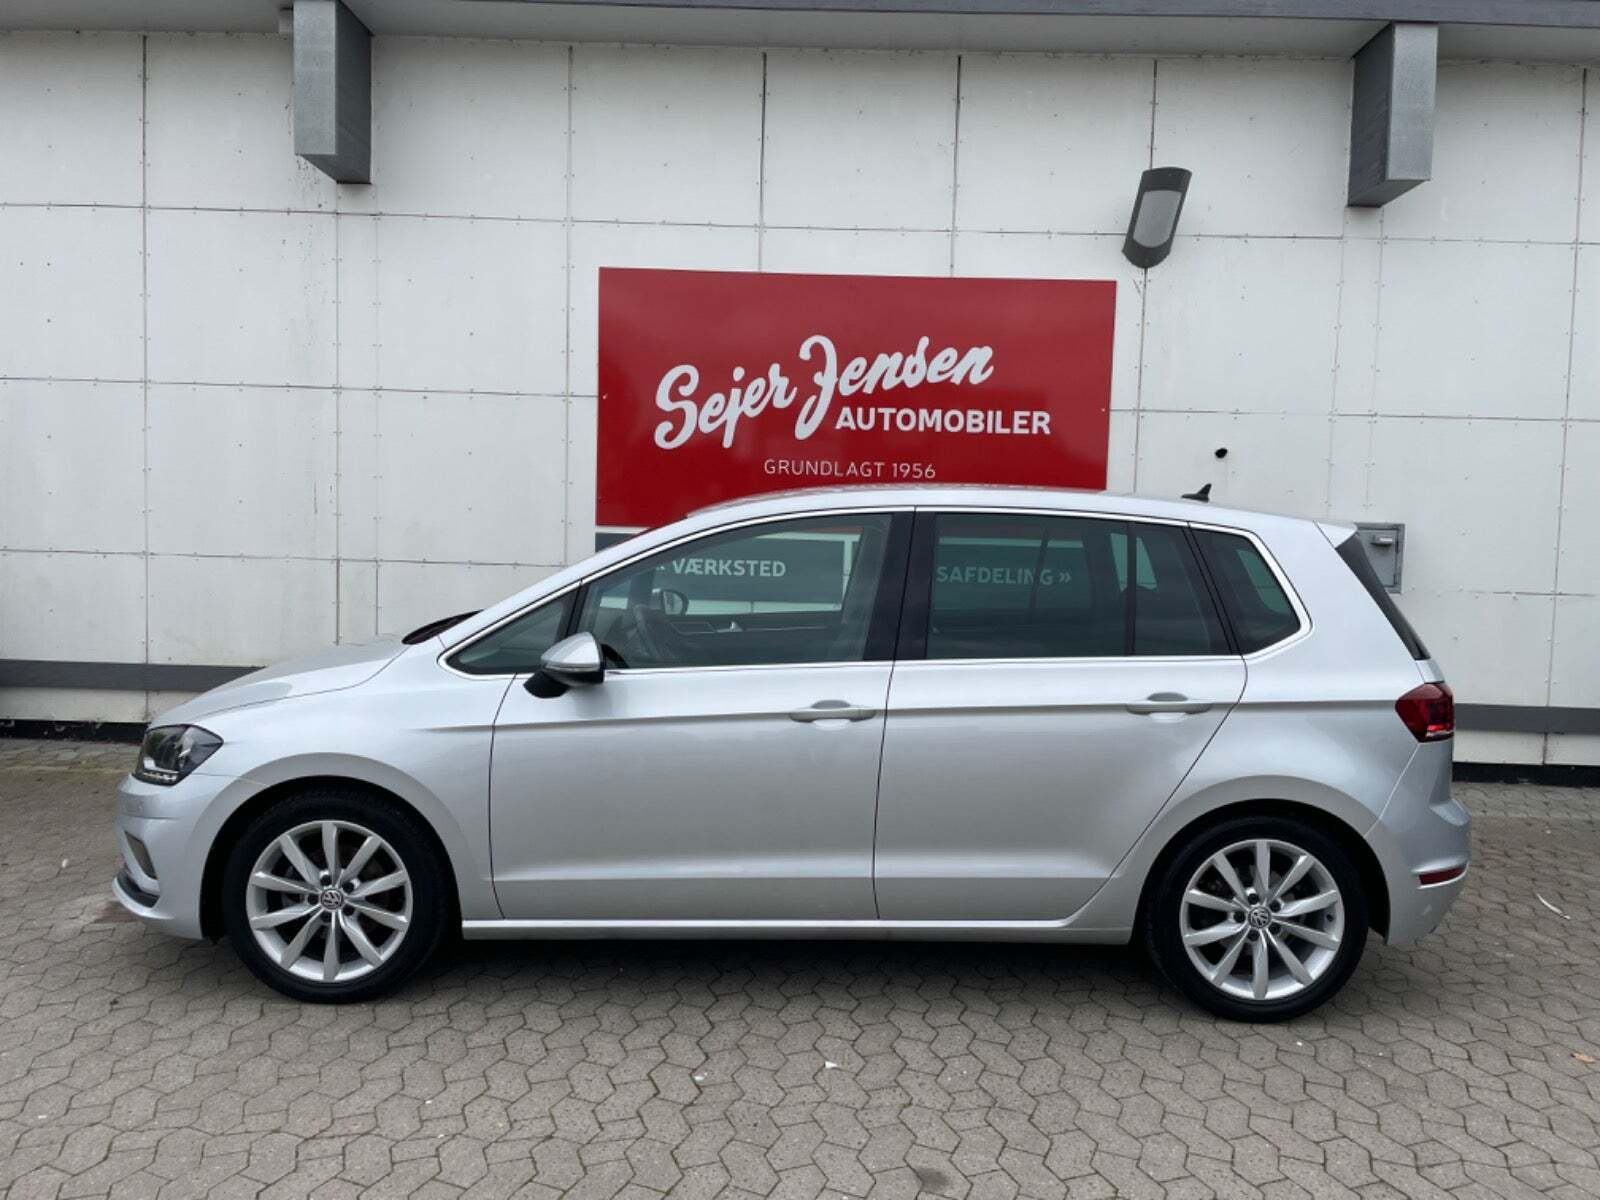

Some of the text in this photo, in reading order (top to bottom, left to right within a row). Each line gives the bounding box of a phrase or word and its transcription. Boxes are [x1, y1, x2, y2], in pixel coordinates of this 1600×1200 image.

[654, 334, 995, 450] Sejer Jensen
[835, 406, 1051, 435] AUTOMOBILER
[764, 458, 936, 480] GRUNDLAGT 1956
[672, 558, 787, 577] VÆRKSTED
